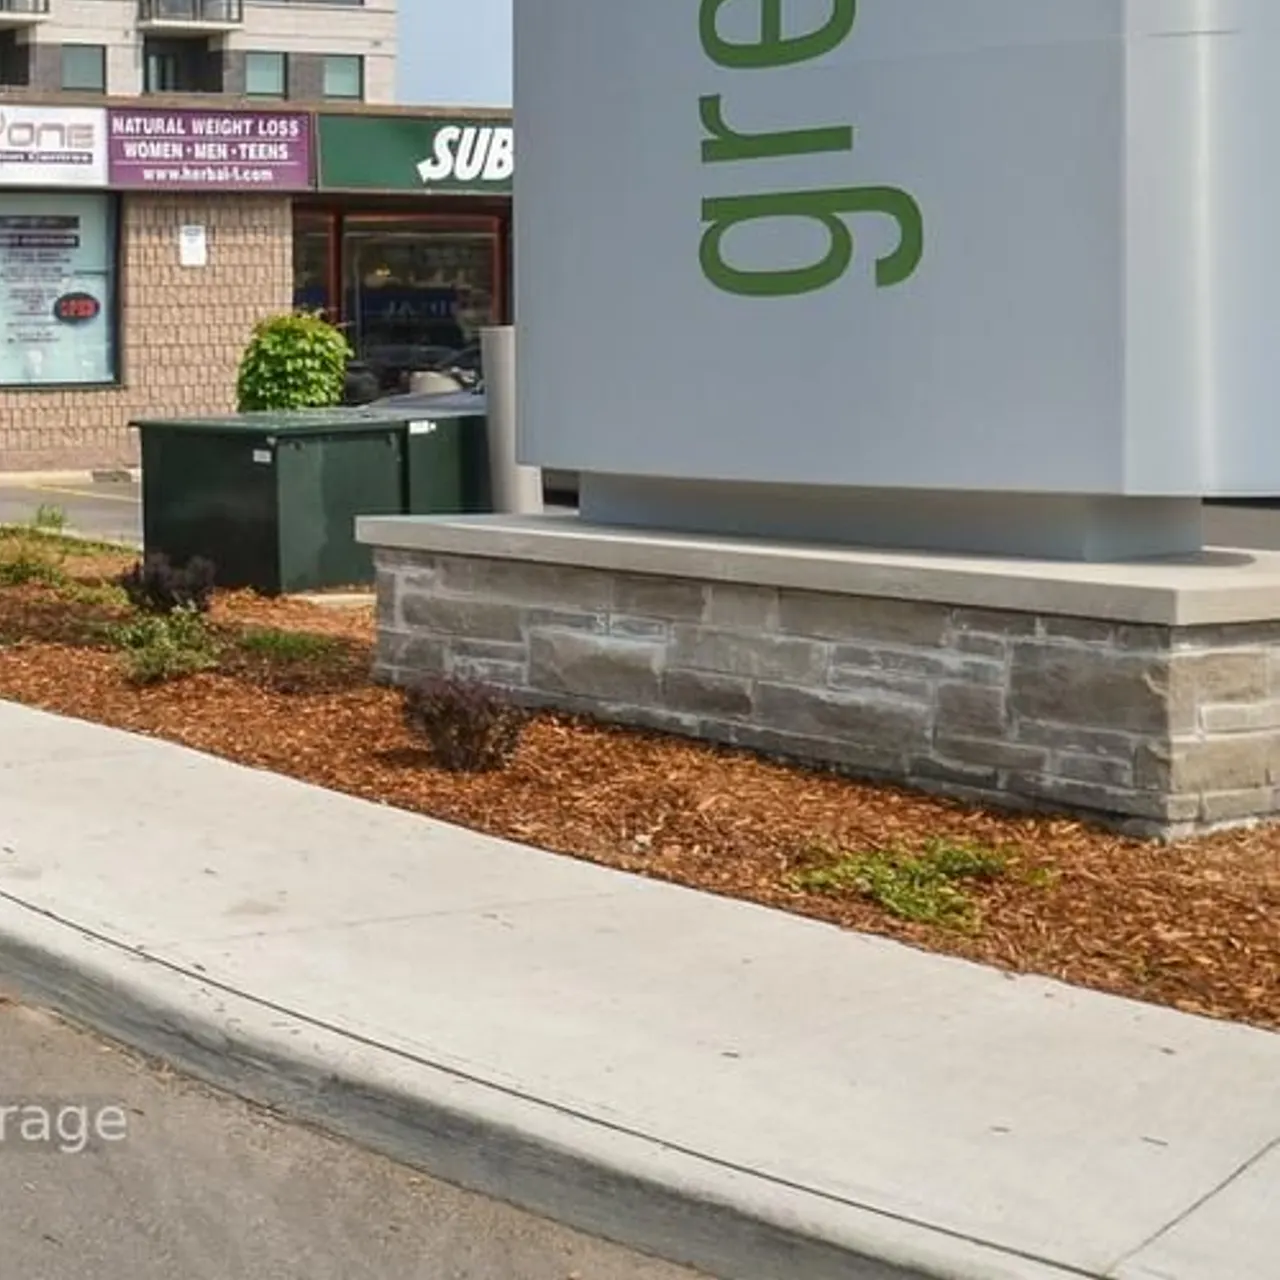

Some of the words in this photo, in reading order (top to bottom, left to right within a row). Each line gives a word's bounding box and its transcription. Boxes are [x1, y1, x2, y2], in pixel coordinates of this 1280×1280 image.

[7, 122, 95, 149] ONE
[112, 117, 186, 134] NATURAL
[192, 118, 253, 135] WEIGHT
[258, 119, 299, 137] LOSS
[123, 142, 183, 158] WOMEN
[194, 143, 228, 159] MEN
[239, 143, 288, 160] TEENS
